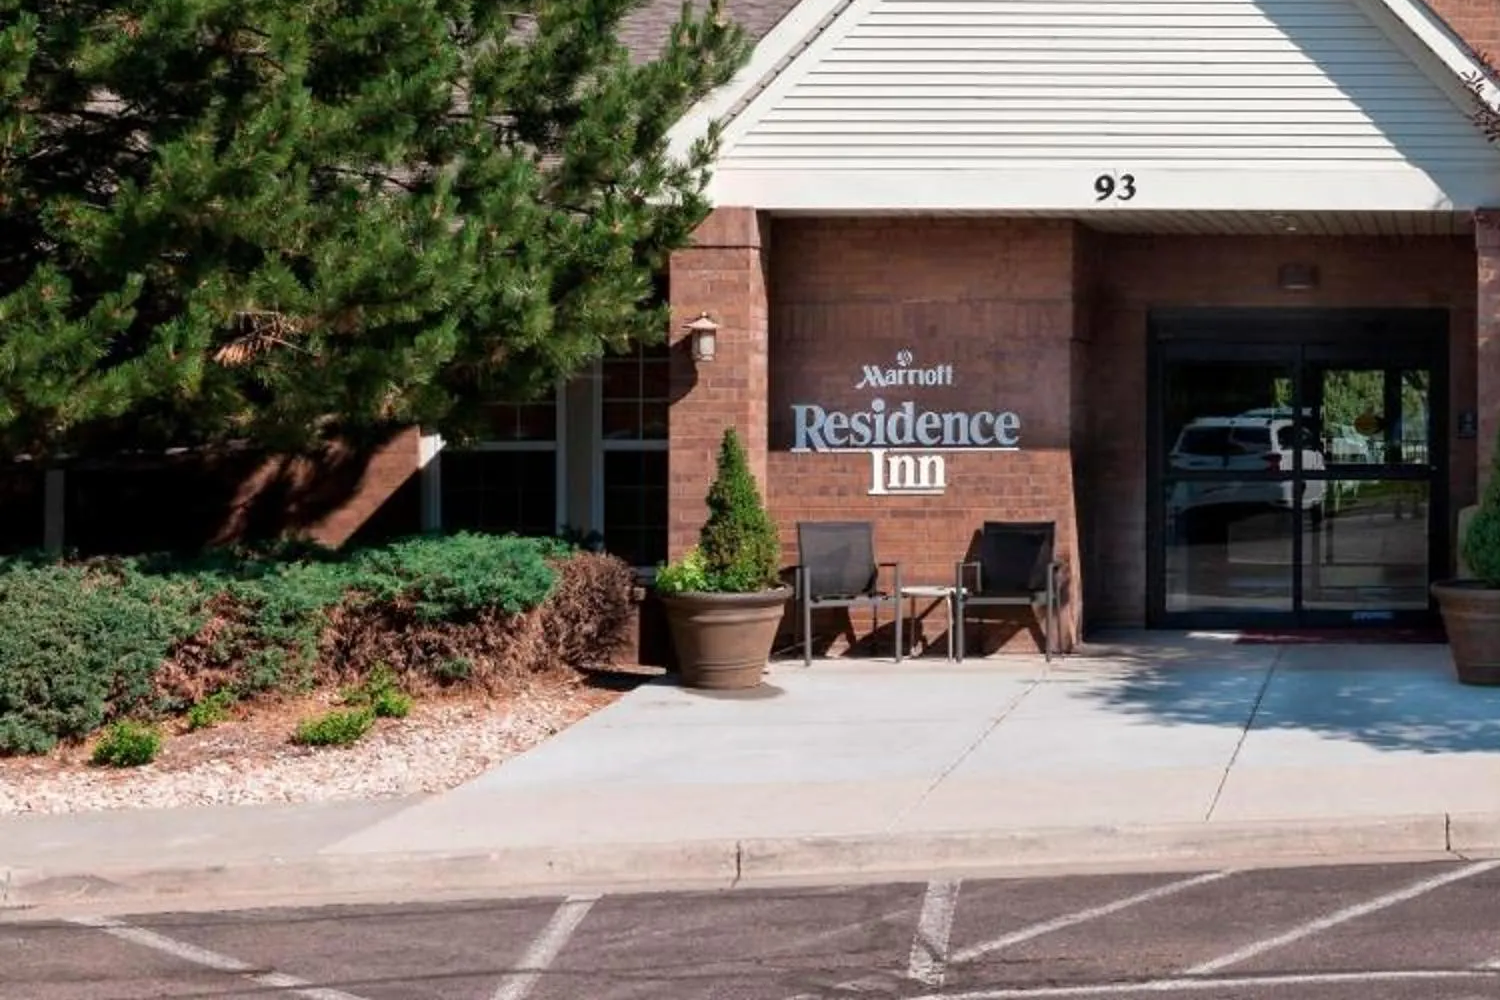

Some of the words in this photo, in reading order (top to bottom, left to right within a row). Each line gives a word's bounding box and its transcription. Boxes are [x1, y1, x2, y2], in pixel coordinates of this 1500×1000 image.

[1094, 174, 1136, 201] 93
[854, 364, 953, 389] Marriott
[790, 398, 1020, 452] Residence
[867, 449, 946, 495] Inn
